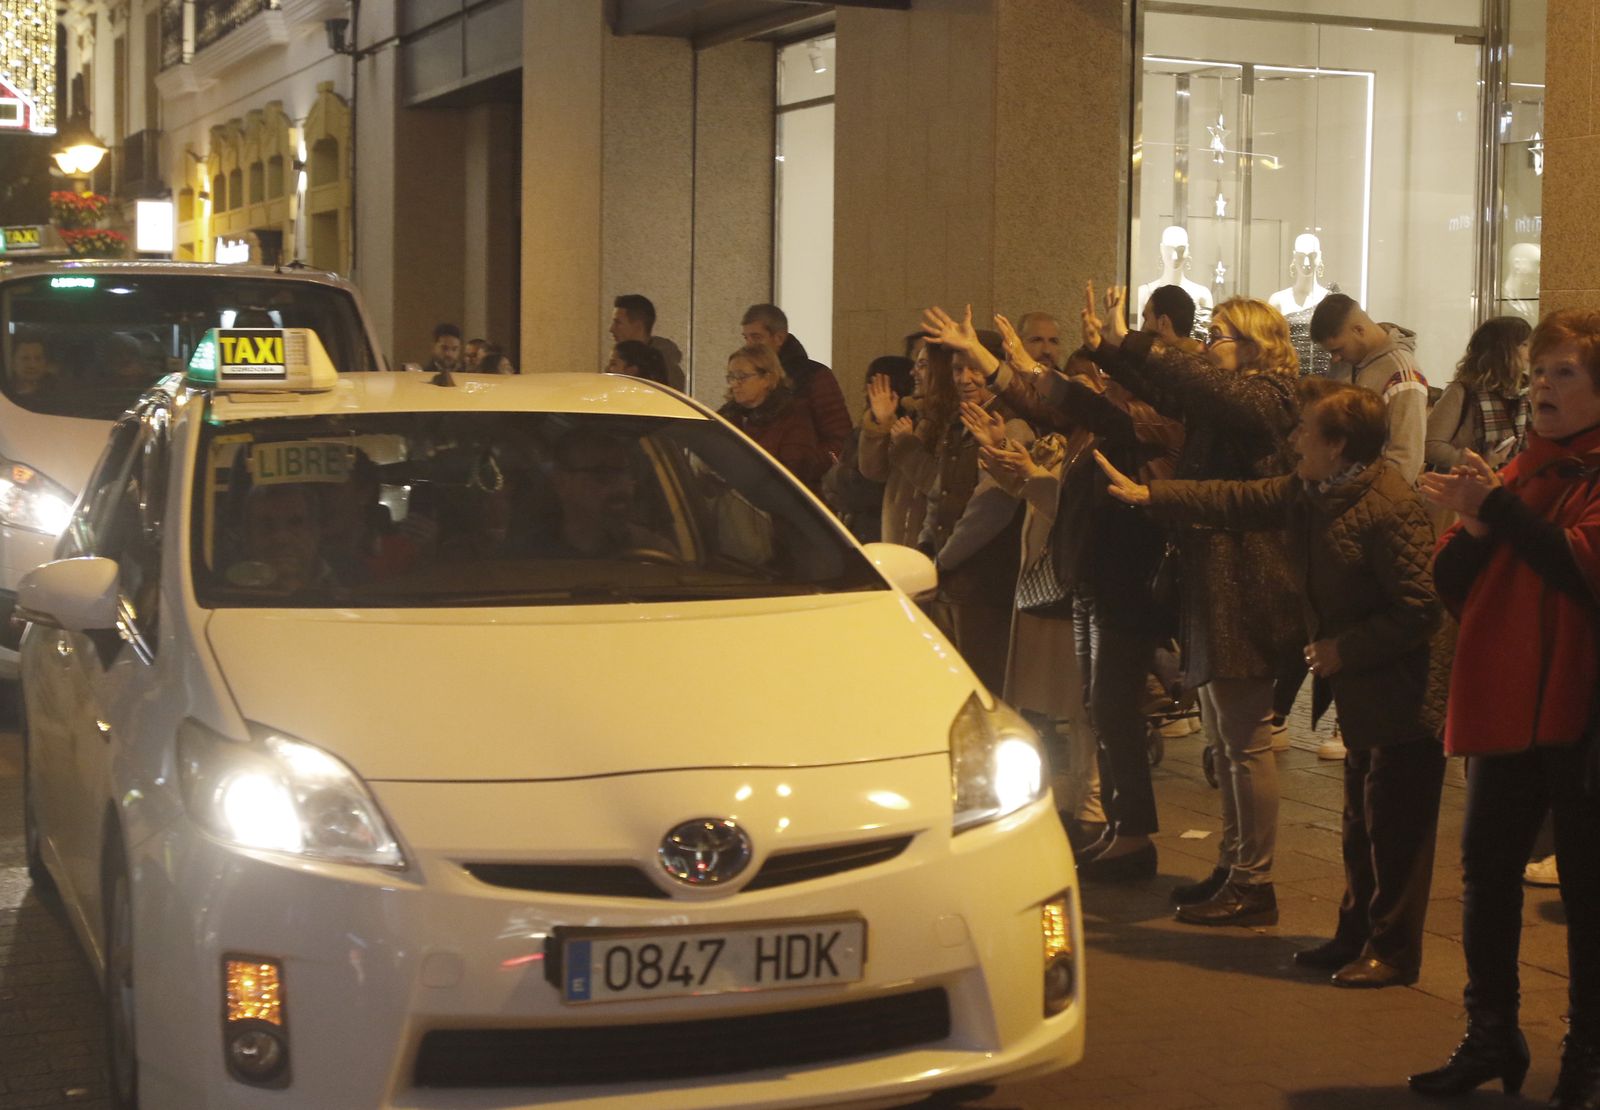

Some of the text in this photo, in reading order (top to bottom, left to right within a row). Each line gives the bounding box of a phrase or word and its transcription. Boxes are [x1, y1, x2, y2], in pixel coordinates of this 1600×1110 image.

[5, 230, 39, 243] TAXI
[218, 336, 285, 364] TAXI
[258, 446, 344, 478] LIBRE
[604, 931, 842, 992] 0847 HDK
